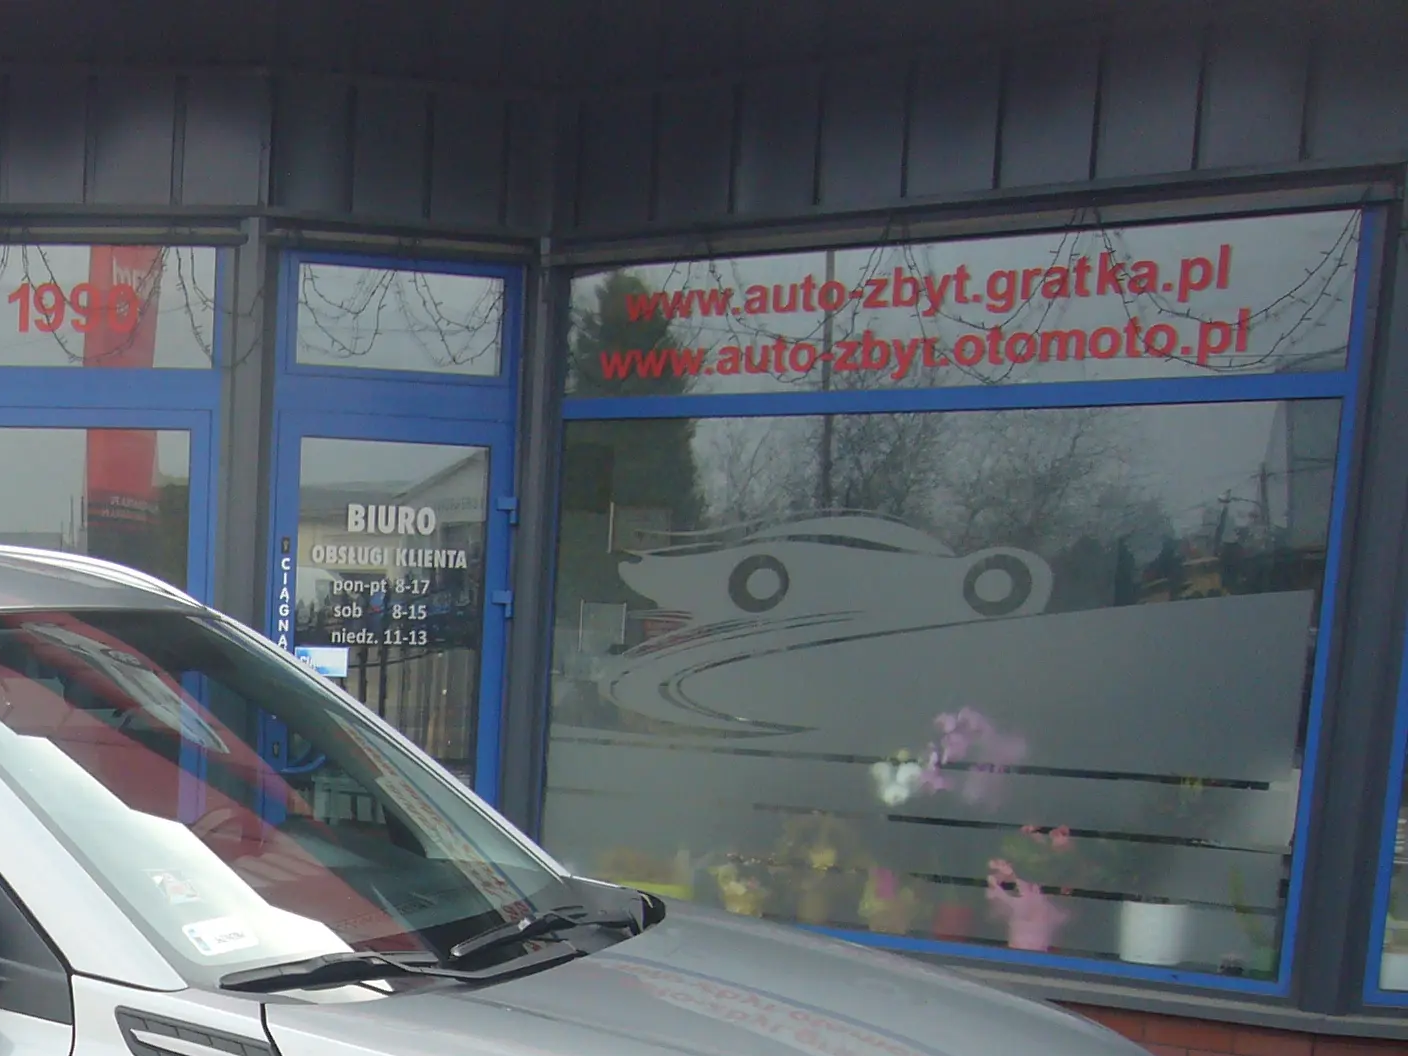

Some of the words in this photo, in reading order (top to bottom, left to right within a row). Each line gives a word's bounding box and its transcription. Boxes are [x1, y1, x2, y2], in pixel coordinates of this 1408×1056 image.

[626, 244, 1233, 323] www.auto-zbyt.gratka.pl
[8, 282, 141, 334] 1990
[600, 308, 1250, 380] www.auto-zbyt.otomoto.pl
[347, 504, 436, 535] BIURO
[395, 549, 467, 569] KLIENTA
[333, 579, 387, 596] pon-pt
[395, 579, 430, 595] 8-17
[333, 603, 362, 618] sob
[392, 604, 427, 619] 8-15
[331, 628, 379, 645] niedz.
[383, 630, 428, 646] 11-13
